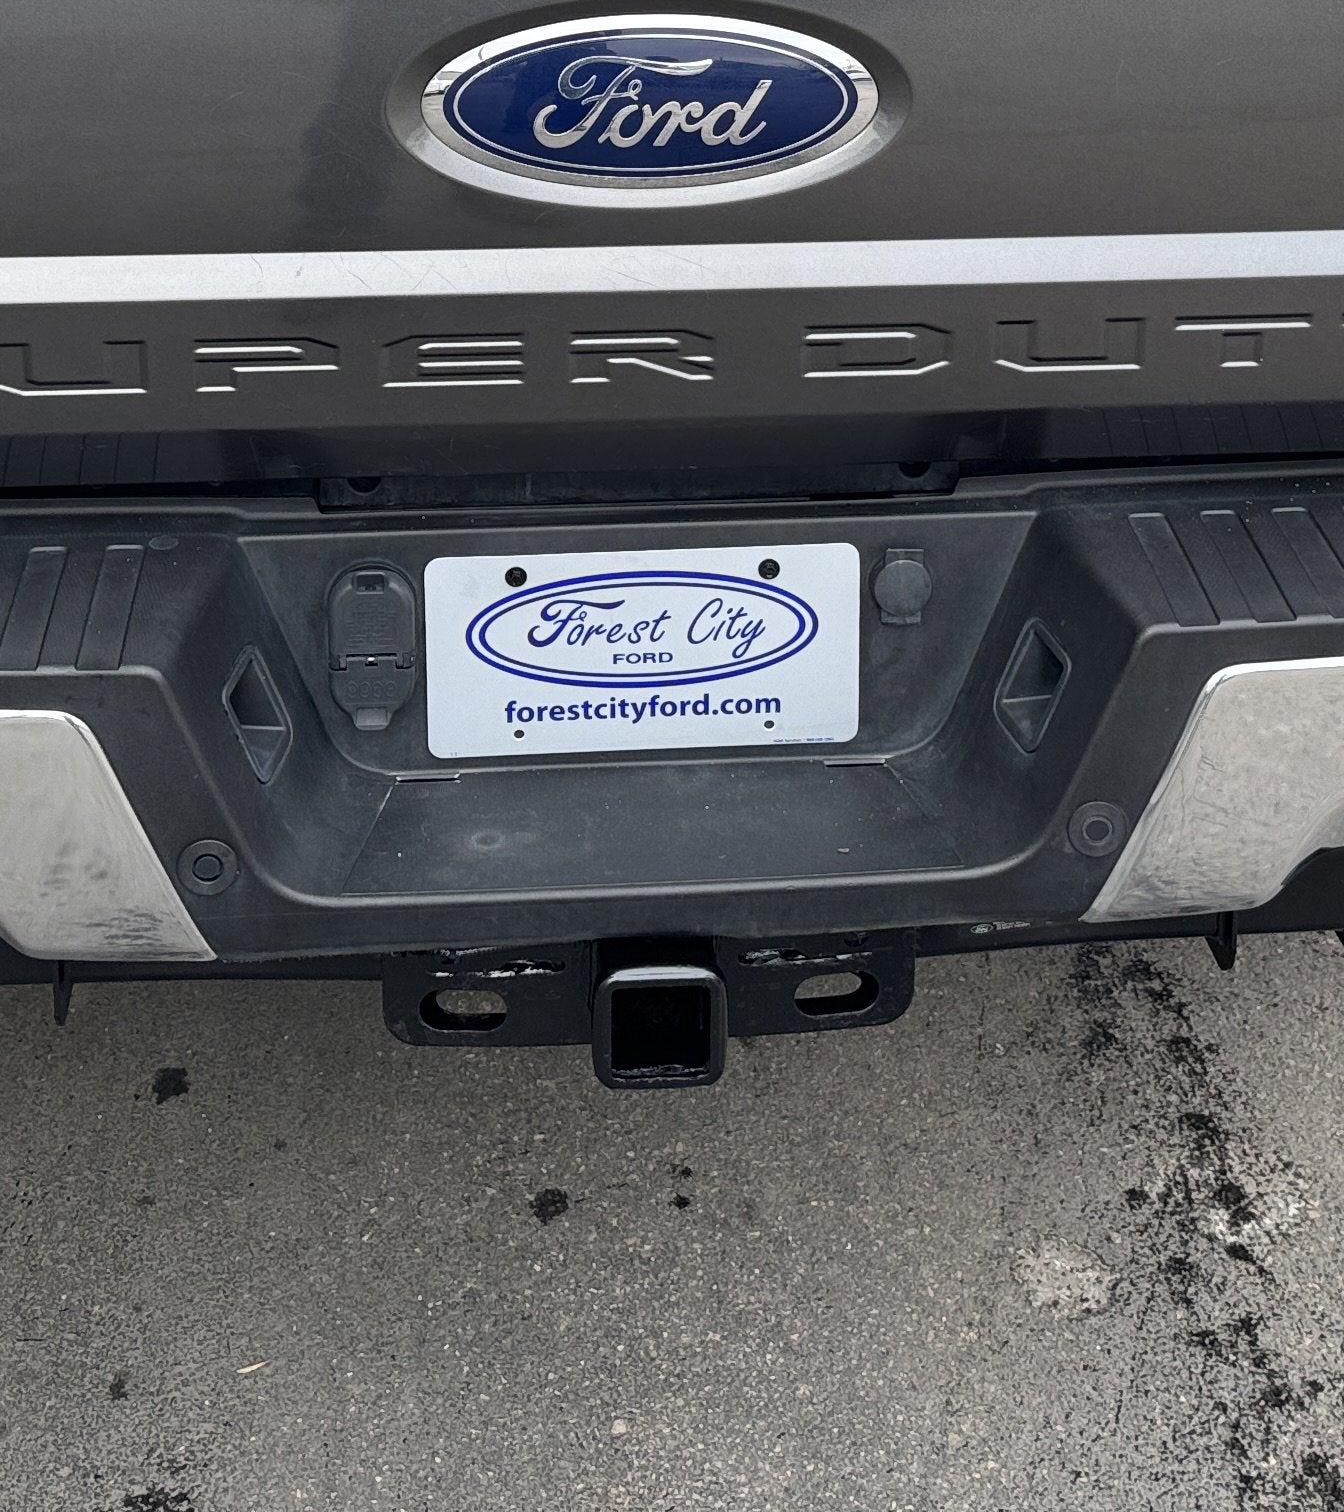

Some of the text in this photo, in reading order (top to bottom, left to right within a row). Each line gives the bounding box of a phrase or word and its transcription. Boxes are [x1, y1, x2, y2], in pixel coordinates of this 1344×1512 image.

[532, 55, 773, 149] Ford
[527, 597, 767, 659] Forest City
[612, 651, 674, 666] FORD
[504, 692, 782, 725] forestcityford.com
